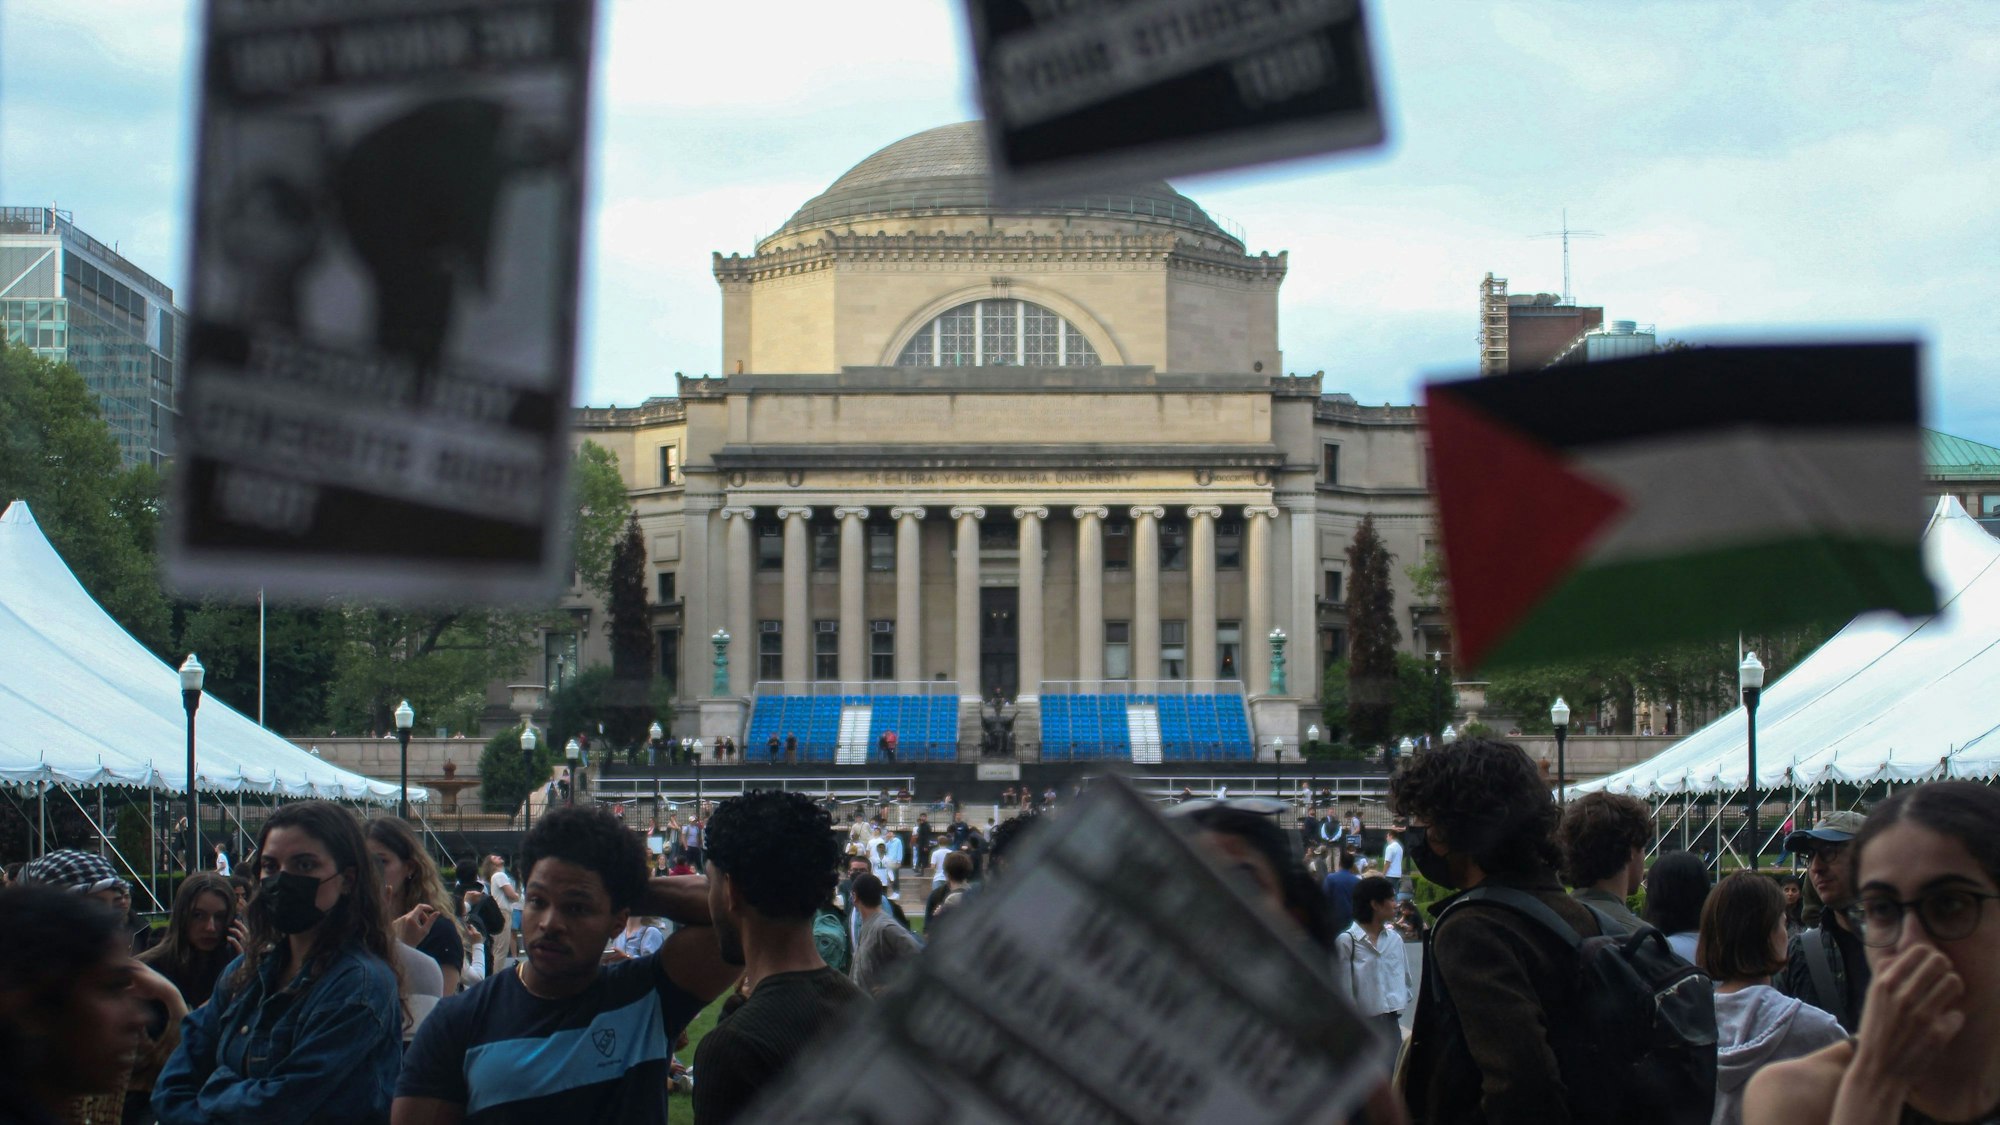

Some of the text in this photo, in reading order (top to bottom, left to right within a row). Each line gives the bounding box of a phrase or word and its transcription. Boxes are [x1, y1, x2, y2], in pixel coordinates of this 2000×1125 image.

[957, 473, 975, 485] OF
[981, 473, 1049, 485] COLUMBIA
[1055, 473, 1134, 485] UNIVERSITY
